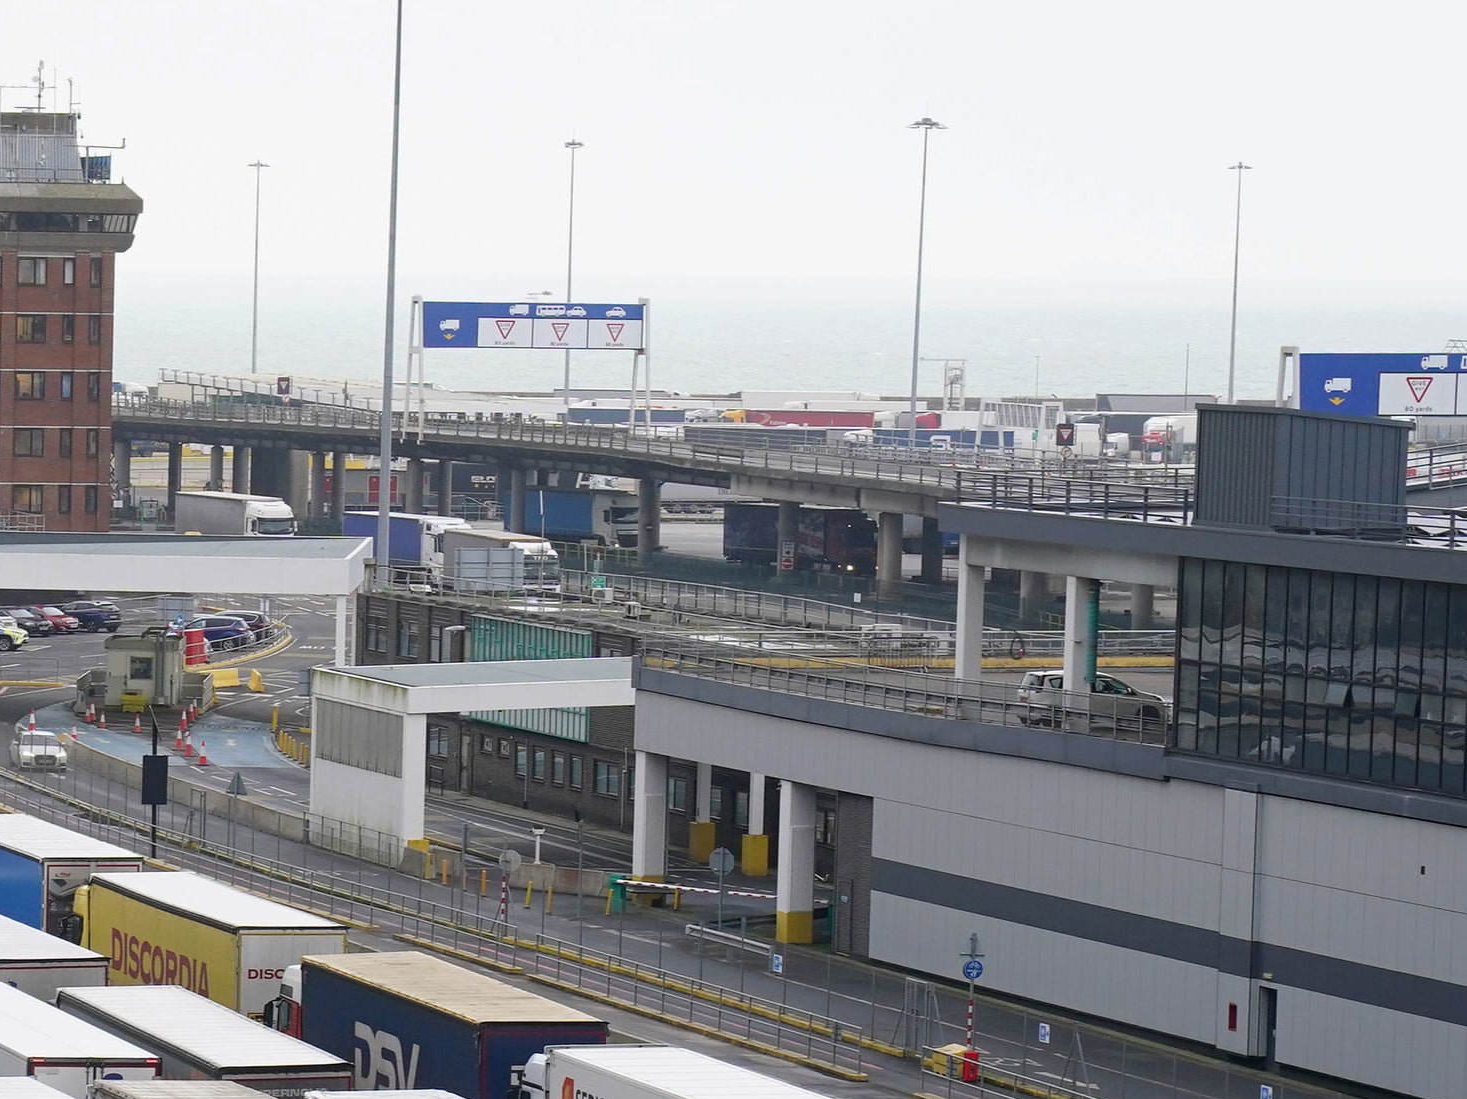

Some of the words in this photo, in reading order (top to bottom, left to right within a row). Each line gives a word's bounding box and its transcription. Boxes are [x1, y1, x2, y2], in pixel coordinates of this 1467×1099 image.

[111, 927, 210, 998] DISCORDIA
[248, 968, 285, 981] DISC
[355, 1021, 420, 1090] DSV
